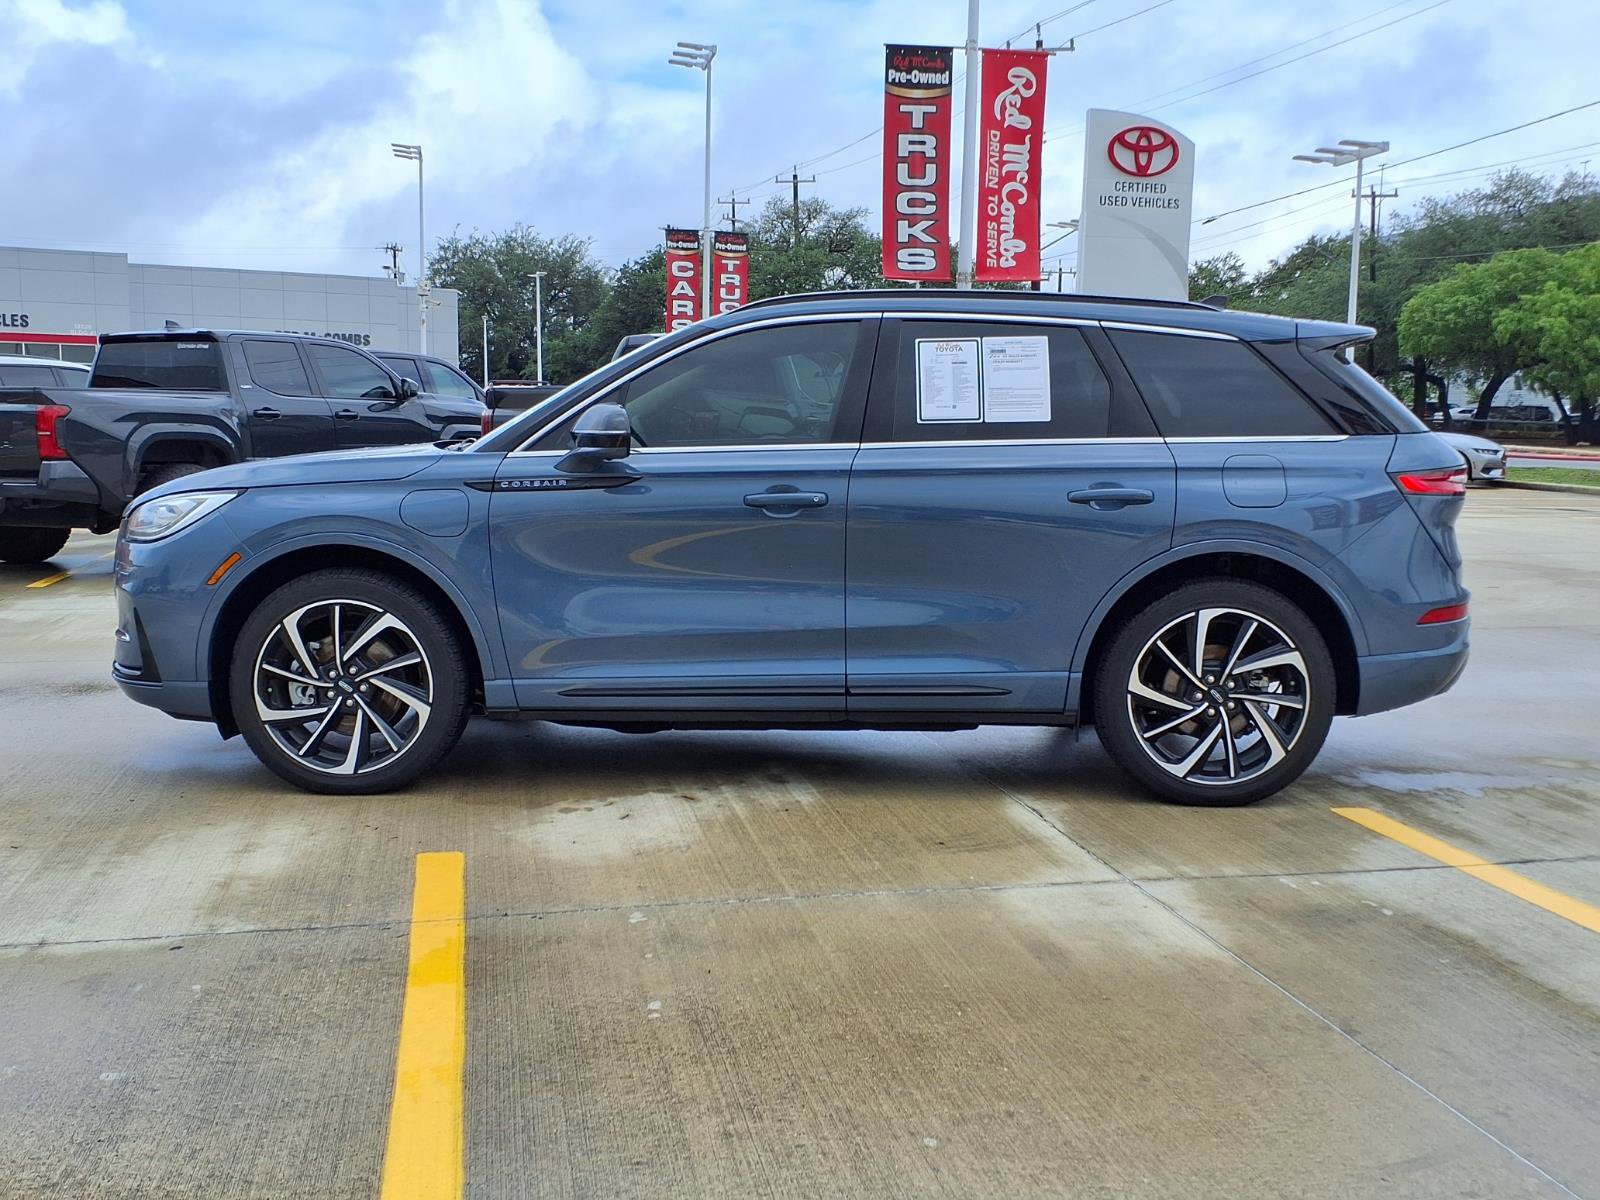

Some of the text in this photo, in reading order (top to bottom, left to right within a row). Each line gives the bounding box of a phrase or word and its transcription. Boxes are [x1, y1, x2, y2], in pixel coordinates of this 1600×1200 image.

[888, 69, 949, 85] Pre-Owned
[994, 66, 1037, 269] Red McCombs
[896, 104, 939, 271] TRUCKS
[1114, 181, 1167, 194] CERTIFIED
[986, 130, 1000, 268] DRIVEN TO SERVE
[1099, 196, 1180, 209] USED VEHICLES
[667, 241, 698, 249] Pre-Owned
[715, 243, 747, 251] Pre-Owned
[0, 313, 29, 328] LES
[500, 479, 567, 488] CORSAIR
